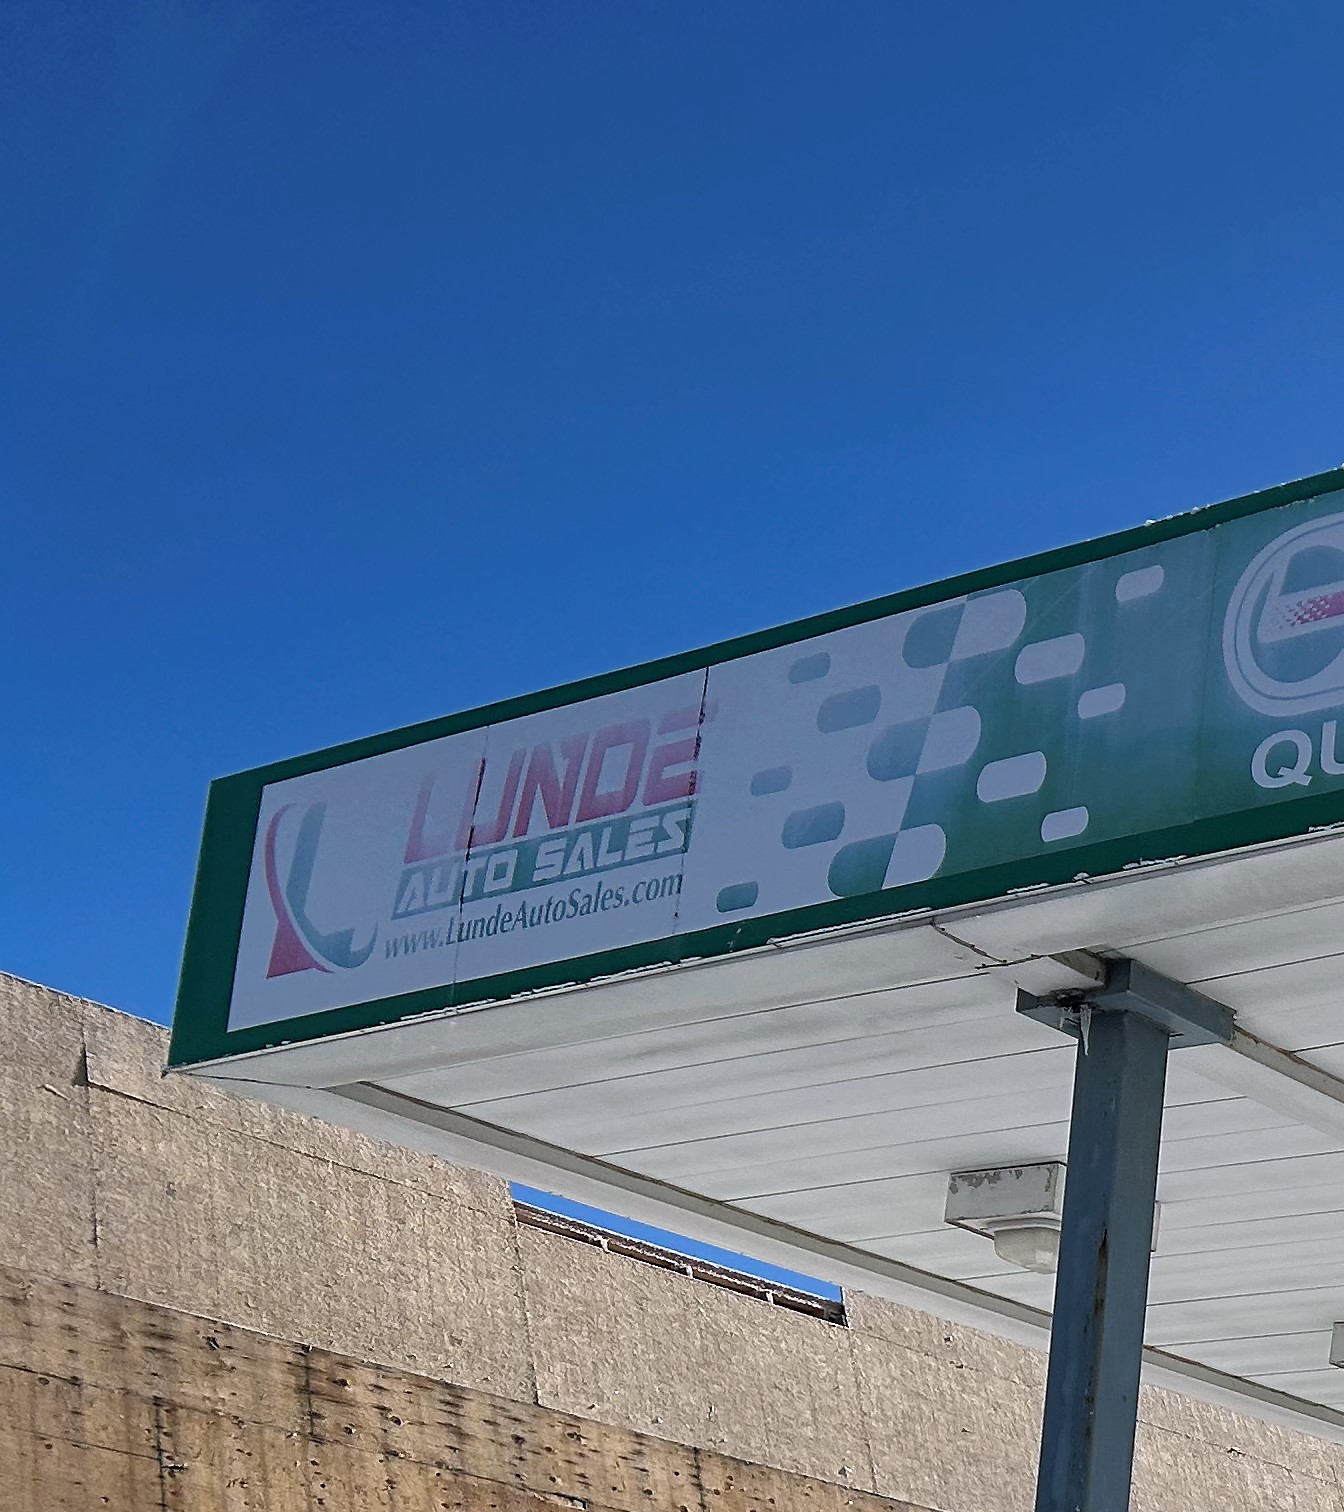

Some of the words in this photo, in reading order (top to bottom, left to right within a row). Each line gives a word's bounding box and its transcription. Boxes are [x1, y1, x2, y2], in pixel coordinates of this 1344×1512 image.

[403, 698, 719, 865] LUNDE
[397, 849, 518, 913] AUTO
[532, 806, 693, 883] SALES
[385, 872, 684, 960] www.LundeAutoSales.com
